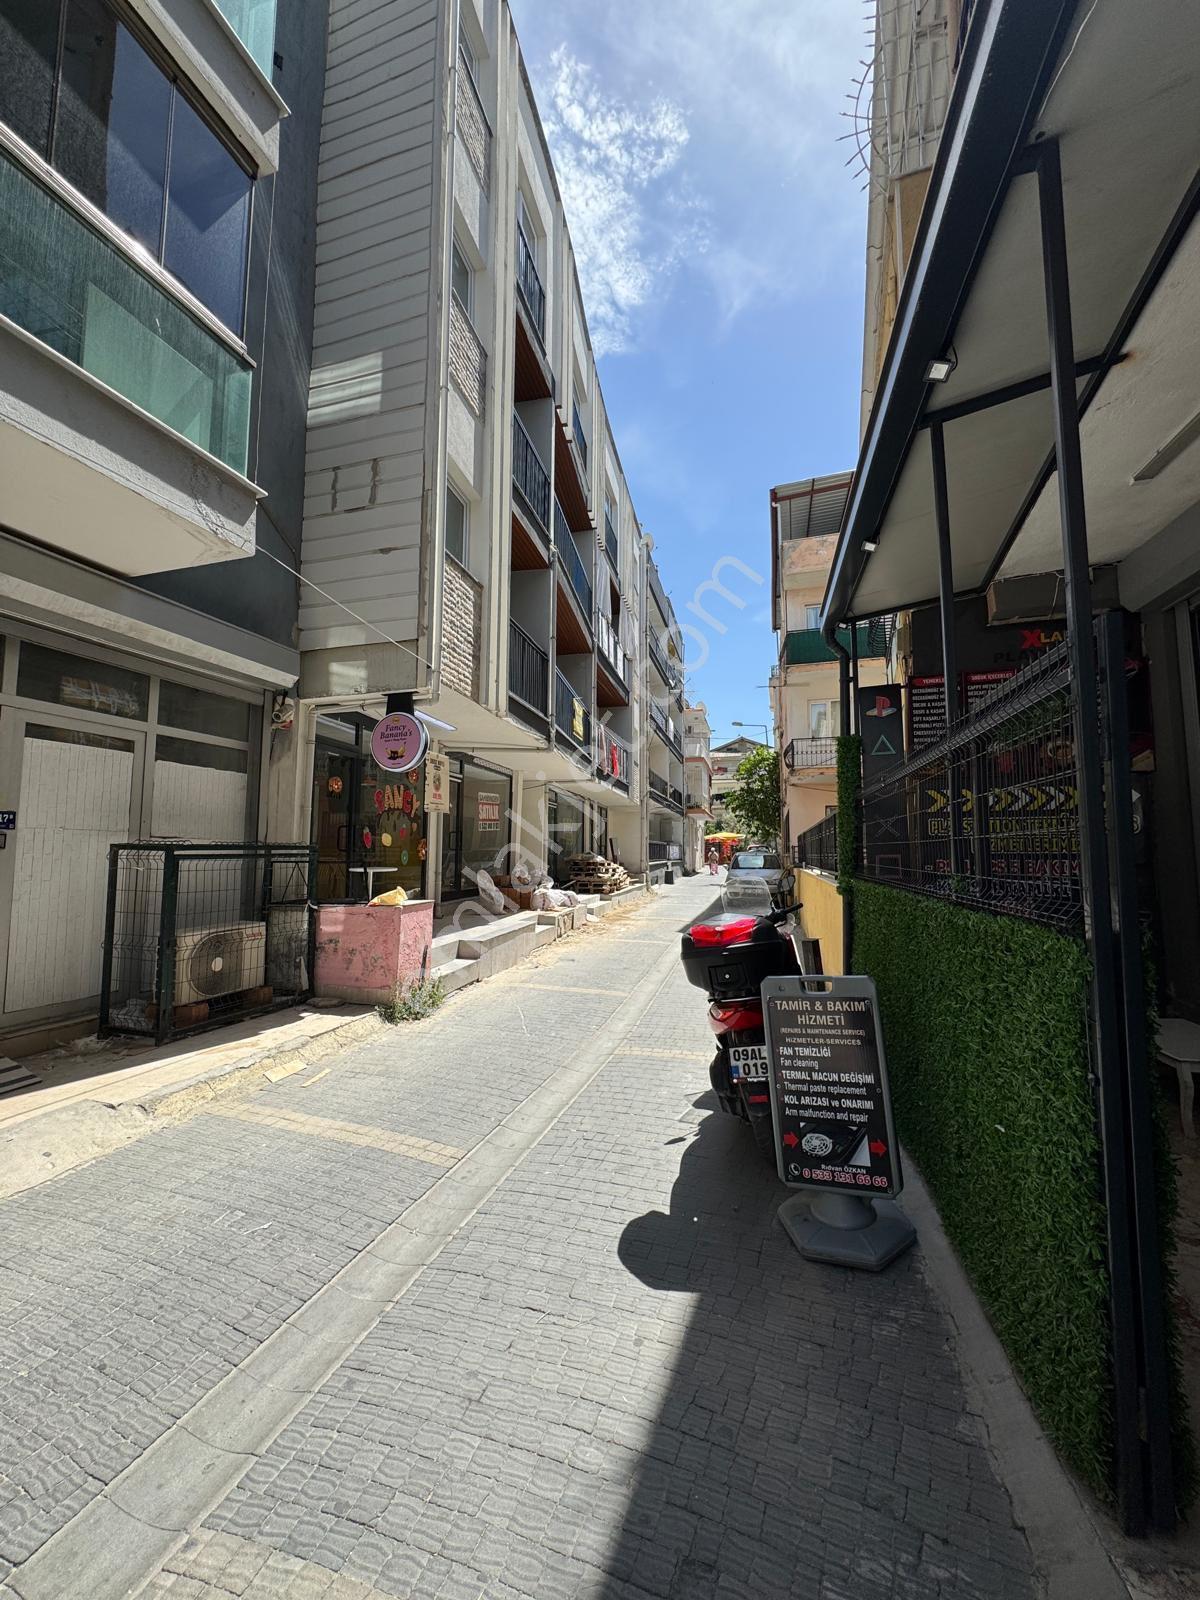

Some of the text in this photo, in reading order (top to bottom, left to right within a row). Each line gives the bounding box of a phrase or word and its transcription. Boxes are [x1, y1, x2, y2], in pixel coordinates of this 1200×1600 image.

[380, 729, 412, 739] Banana's
[385, 724, 406, 732] Fancy
[775, 999, 865, 1012] TAMİR & BAKIM
[798, 1013, 845, 1025] HİZMETİ
[779, 1046, 831, 1057] FAN TEMİZLİĞİ
[742, 1062, 768, 1076] 019
[781, 1057, 819, 1069] Fan cleaning
[782, 1070, 875, 1085] TERMAL MACUN DEĞİŞİMİ
[784, 1082, 867, 1096] Thermal paste replacement
[784, 1095, 799, 1104] KOL
[800, 1096, 829, 1107] ARIZASI
[841, 1099, 874, 1110] ONARIMI
[785, 1107, 869, 1124] Arm malfunction and repair
[843, 1165, 866, 1174] ÖZKAN
[803, 1168, 887, 1187] 0 533 131 66 66
